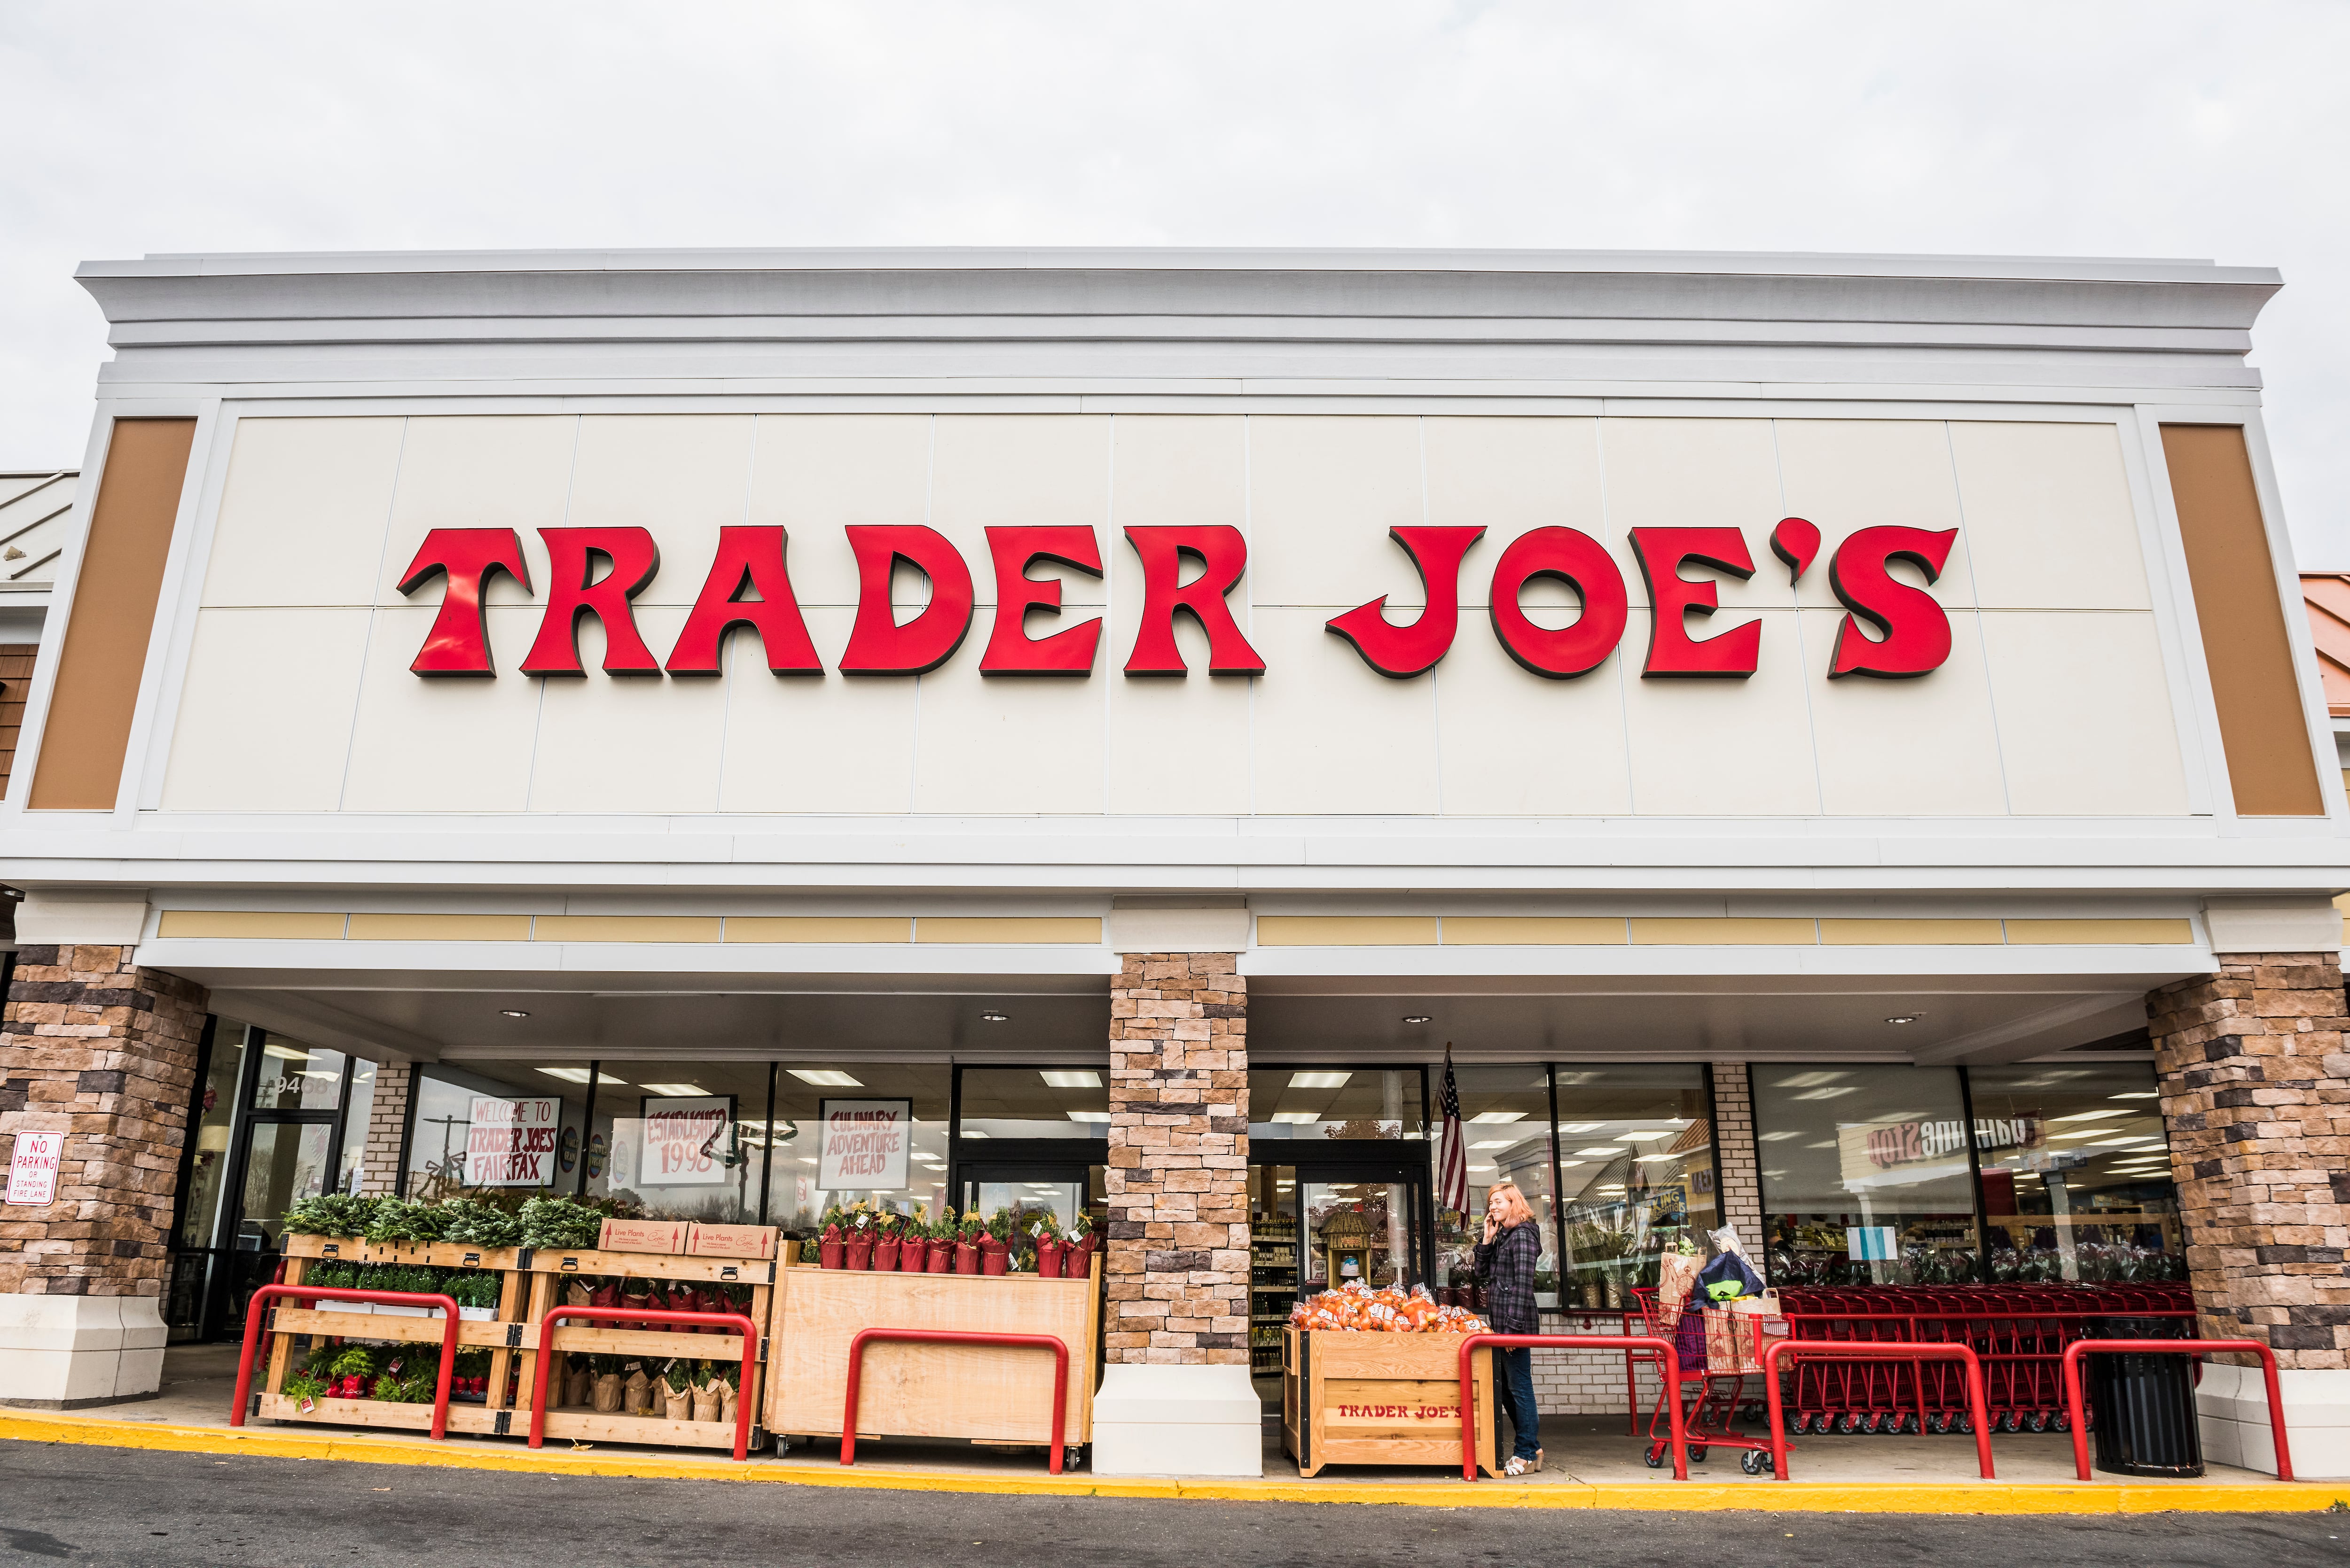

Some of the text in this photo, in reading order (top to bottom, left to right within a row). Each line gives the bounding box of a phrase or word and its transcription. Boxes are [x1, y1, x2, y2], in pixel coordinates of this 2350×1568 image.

[396, 517, 1958, 679] TRADER JOE'S
[274, 1076, 328, 1094] 9468
[476, 1101, 551, 1122] WELCOME TO
[830, 1109, 898, 1132] CULINARY
[647, 1108, 727, 1145] ESTABLISHED
[30, 1140, 47, 1153] NO
[469, 1128, 523, 1153] TRADER
[591, 1143, 608, 1156] ANDWICH
[826, 1131, 900, 1156] ADVENTURE
[17, 1156, 55, 1170] PARKING
[474, 1152, 541, 1181] FAIRFAX
[661, 1140, 713, 1174] 1998
[838, 1154, 886, 1178] AHEAD
[1651, 1201, 1686, 1222] ssentials
[1338, 1405, 1462, 1418] TRADER JOE'S
